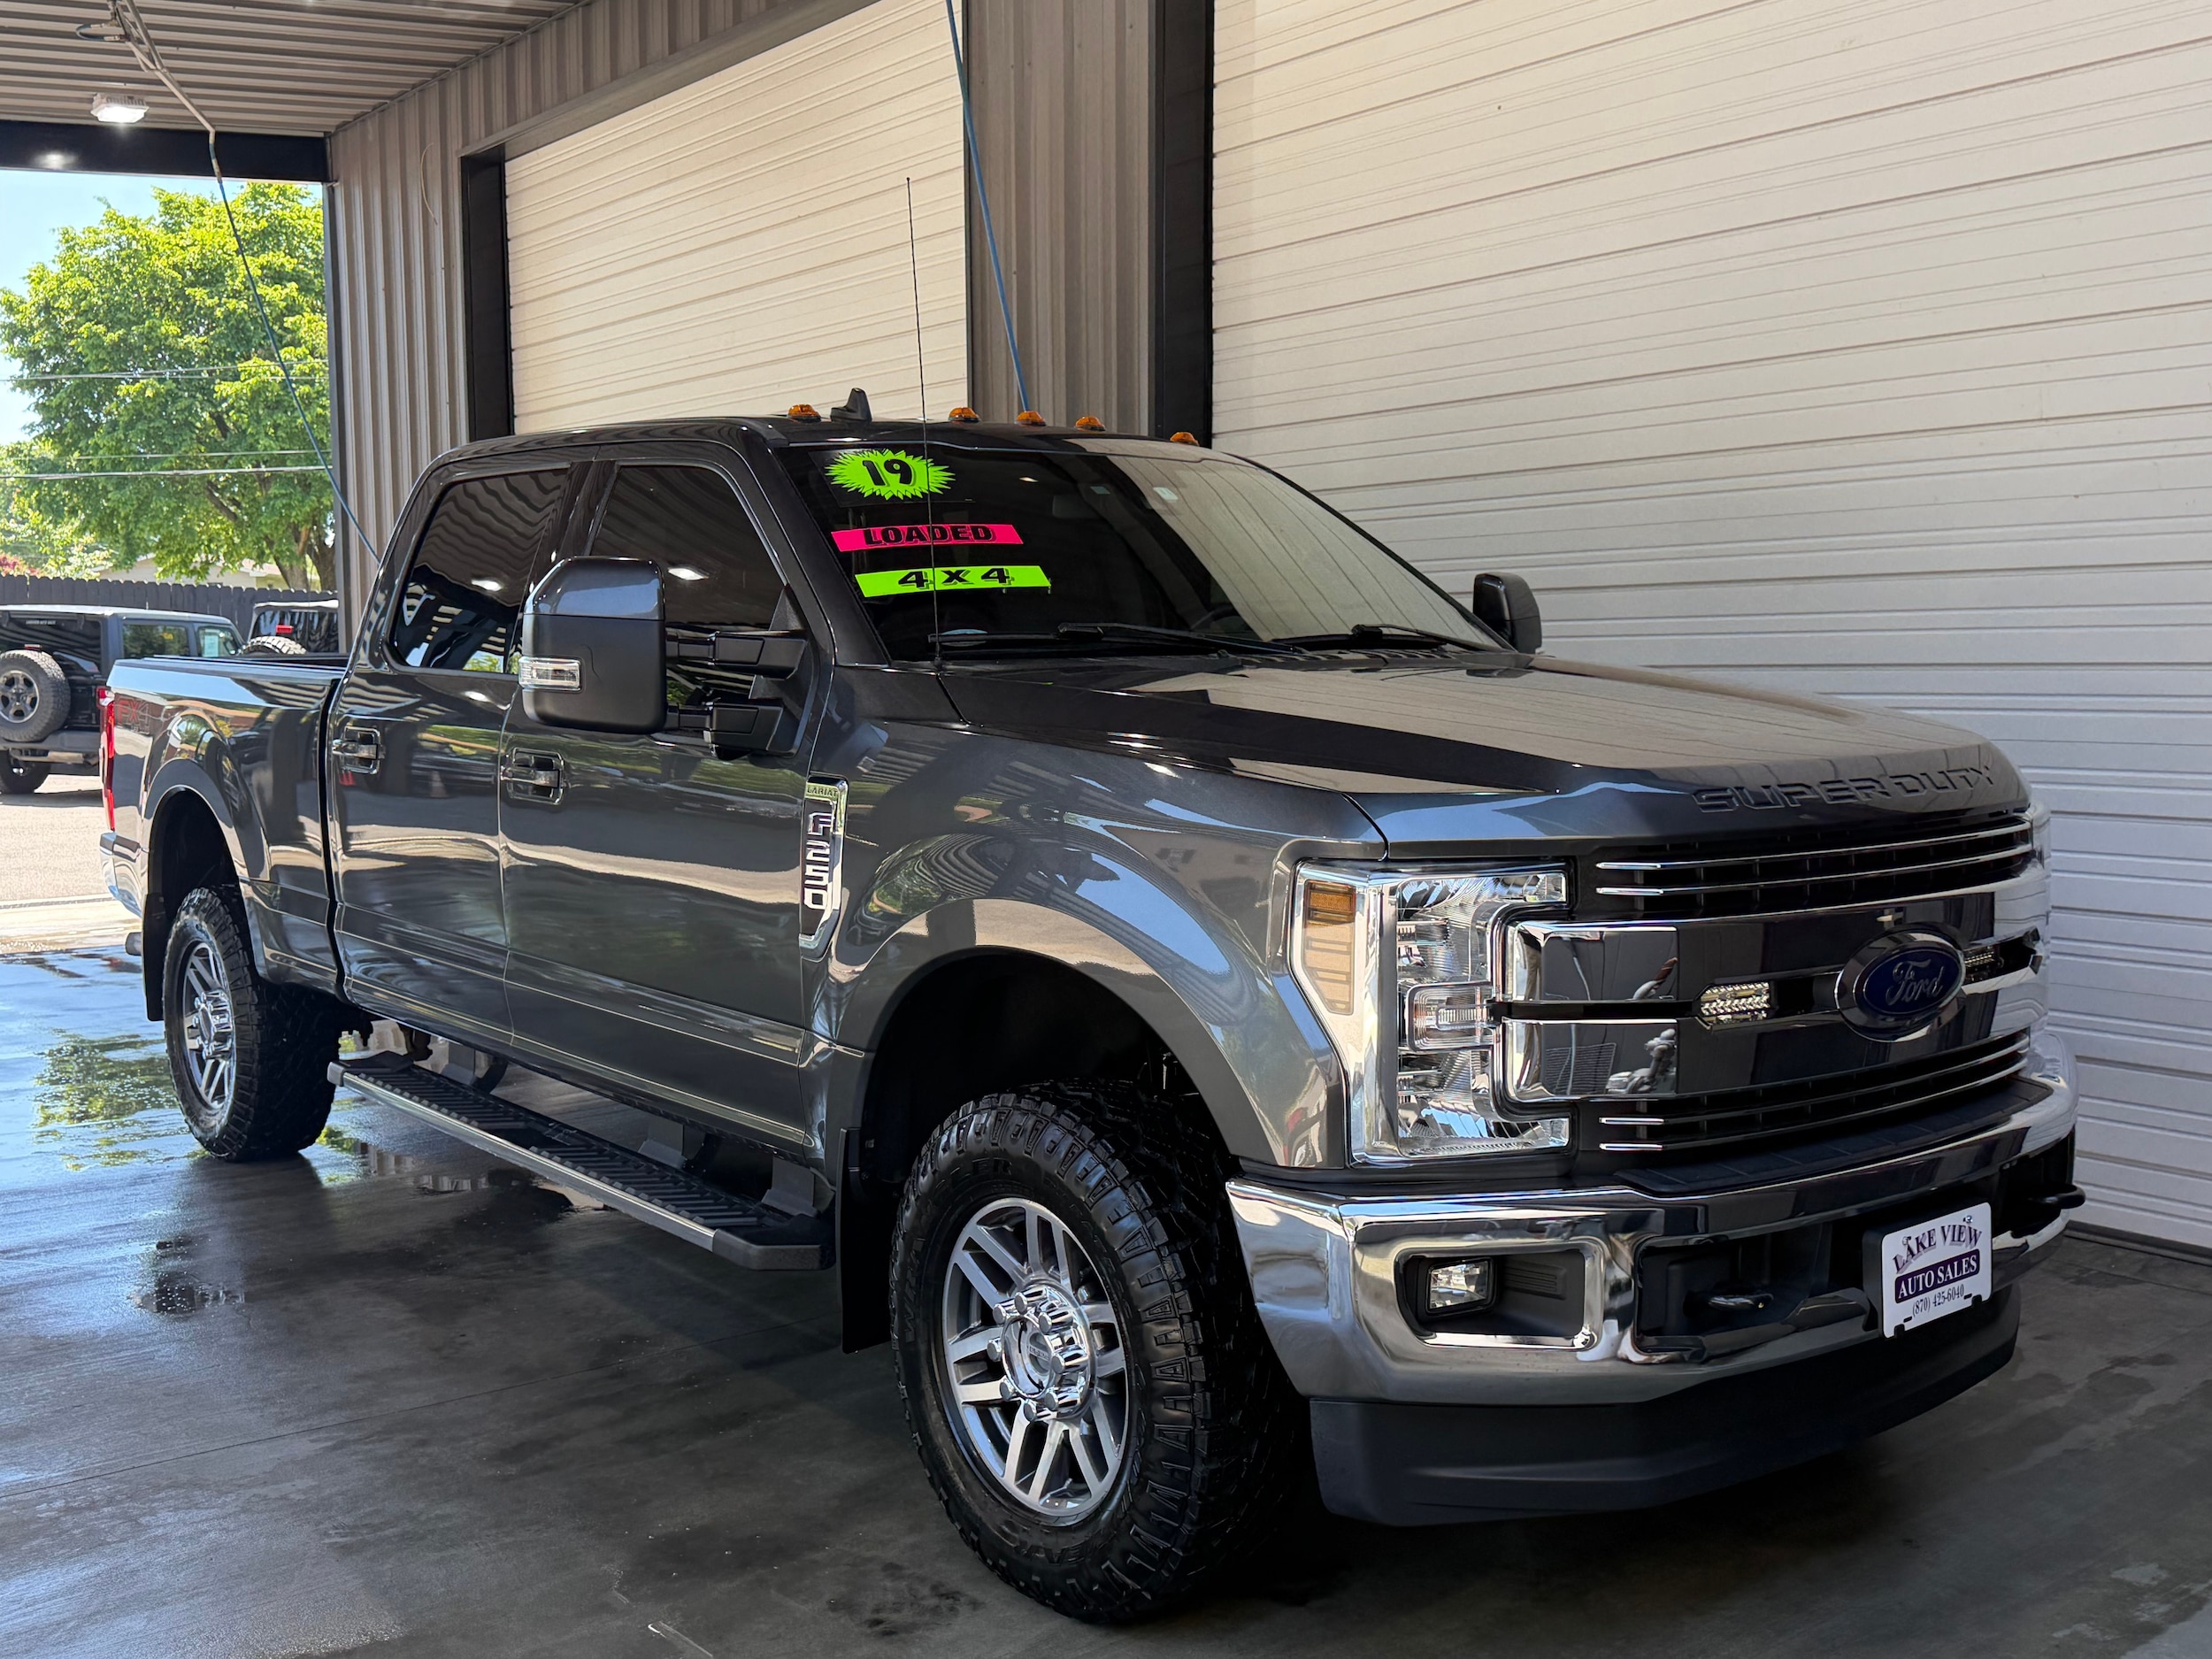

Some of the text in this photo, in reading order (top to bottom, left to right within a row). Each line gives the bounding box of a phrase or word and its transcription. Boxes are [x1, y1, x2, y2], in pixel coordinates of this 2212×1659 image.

[862, 458, 915, 487] 19
[864, 525, 996, 546] LOADED
[117, 698, 150, 727] FX4
[806, 787, 839, 797] LARIAT
[1693, 764, 1994, 813] SUPER DUTY
[1886, 958, 1946, 1006] Ford
[1893, 1224, 1983, 1274] LAKE VIEW
[1898, 1255, 1978, 1300] AUTO SALES
[1912, 1296, 1931, 1317] (870)
